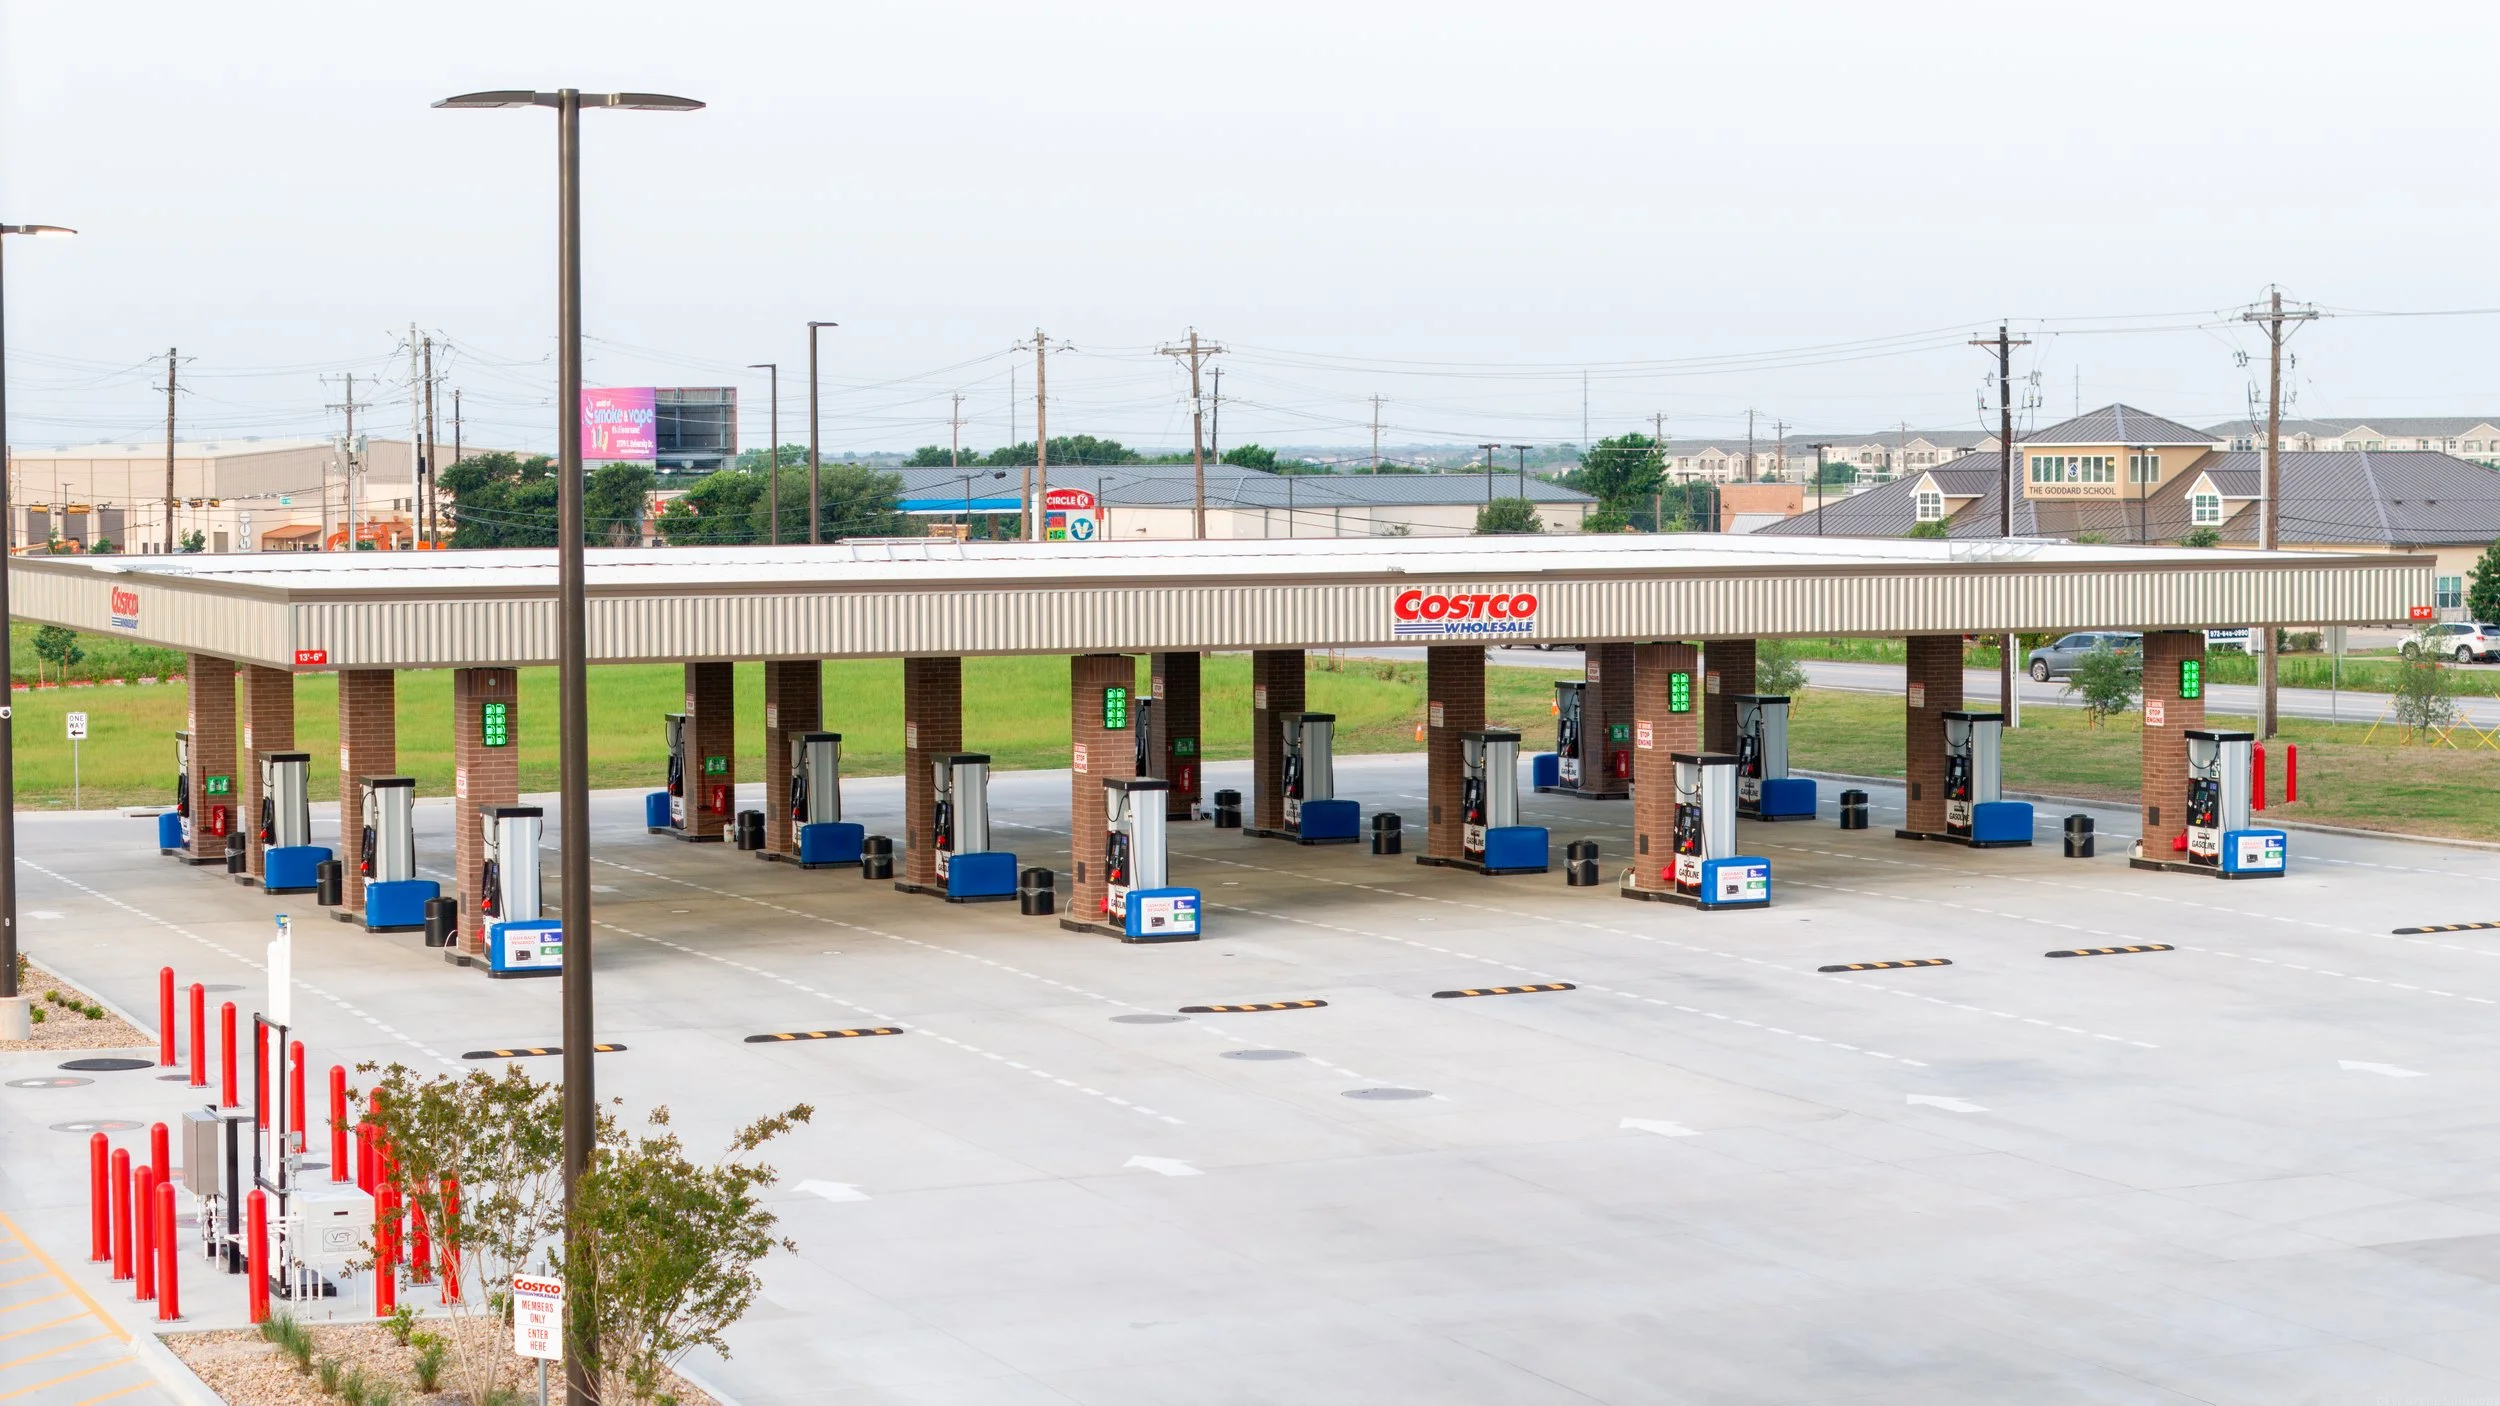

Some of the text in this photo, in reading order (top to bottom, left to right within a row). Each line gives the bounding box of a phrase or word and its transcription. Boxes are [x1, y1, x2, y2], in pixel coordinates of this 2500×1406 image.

[593, 404, 653, 428] smoke & vape
[2029, 486, 2116, 495] THE GODDARD SCHOOL
[1046, 496, 1076, 505] CIRCLE
[1394, 589, 1538, 620] COSTCO
[1444, 621, 1533, 634] WHOLESALE
[2192, 840, 2216, 850] GASOLINE
[1678, 868, 1700, 880] GASOLINE
[514, 1279, 561, 1294] COSTCO
[522, 1300, 554, 1313] MEMBERS
[530, 1313, 546, 1324] ONLY
[528, 1328, 549, 1339] ENTER
[530, 1340, 547, 1351] HERE
